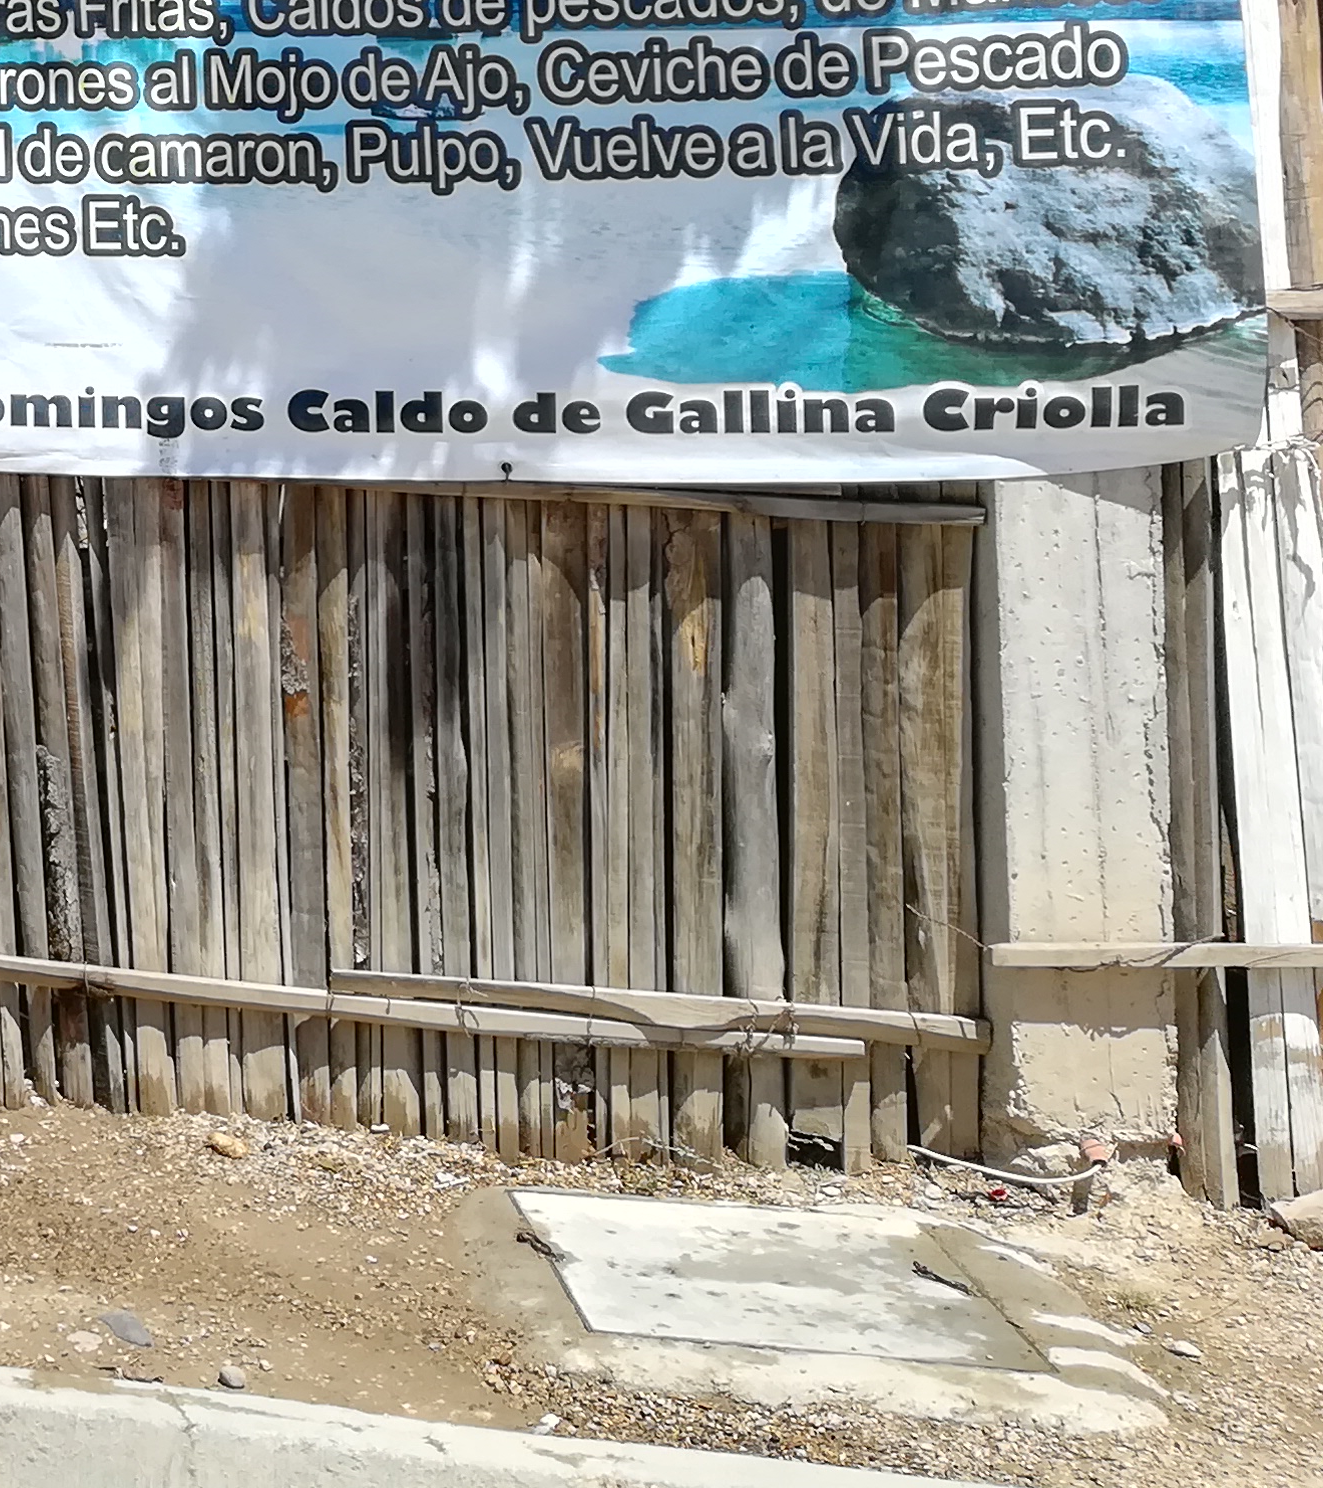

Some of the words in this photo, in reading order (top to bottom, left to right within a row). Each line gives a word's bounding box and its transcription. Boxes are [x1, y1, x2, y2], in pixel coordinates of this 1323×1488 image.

[149, 53, 193, 107] al
[208, 50, 333, 121] Mojo
[346, 48, 413, 105] de
[424, 49, 527, 113] Ajo,
[543, 40, 764, 99] Ceviche
[779, 36, 854, 93] de
[868, 27, 1124, 90] Pescado
[21, 126, 86, 181] de
[98, 133, 335, 187] camaron,
[349, 124, 518, 193] Pulpo,
[528, 115, 721, 177] Vuelve
[735, 127, 781, 172] a
[782, 115, 837, 171] la
[849, 106, 999, 175] Vida,
[1015, 103, 1129, 165] Etc.
[85, 197, 186, 255] Etc.
[287, 388, 488, 434] Caldo
[512, 391, 601, 435] de
[625, 387, 896, 436] Gallina
[922, 382, 1186, 432] Criolla
